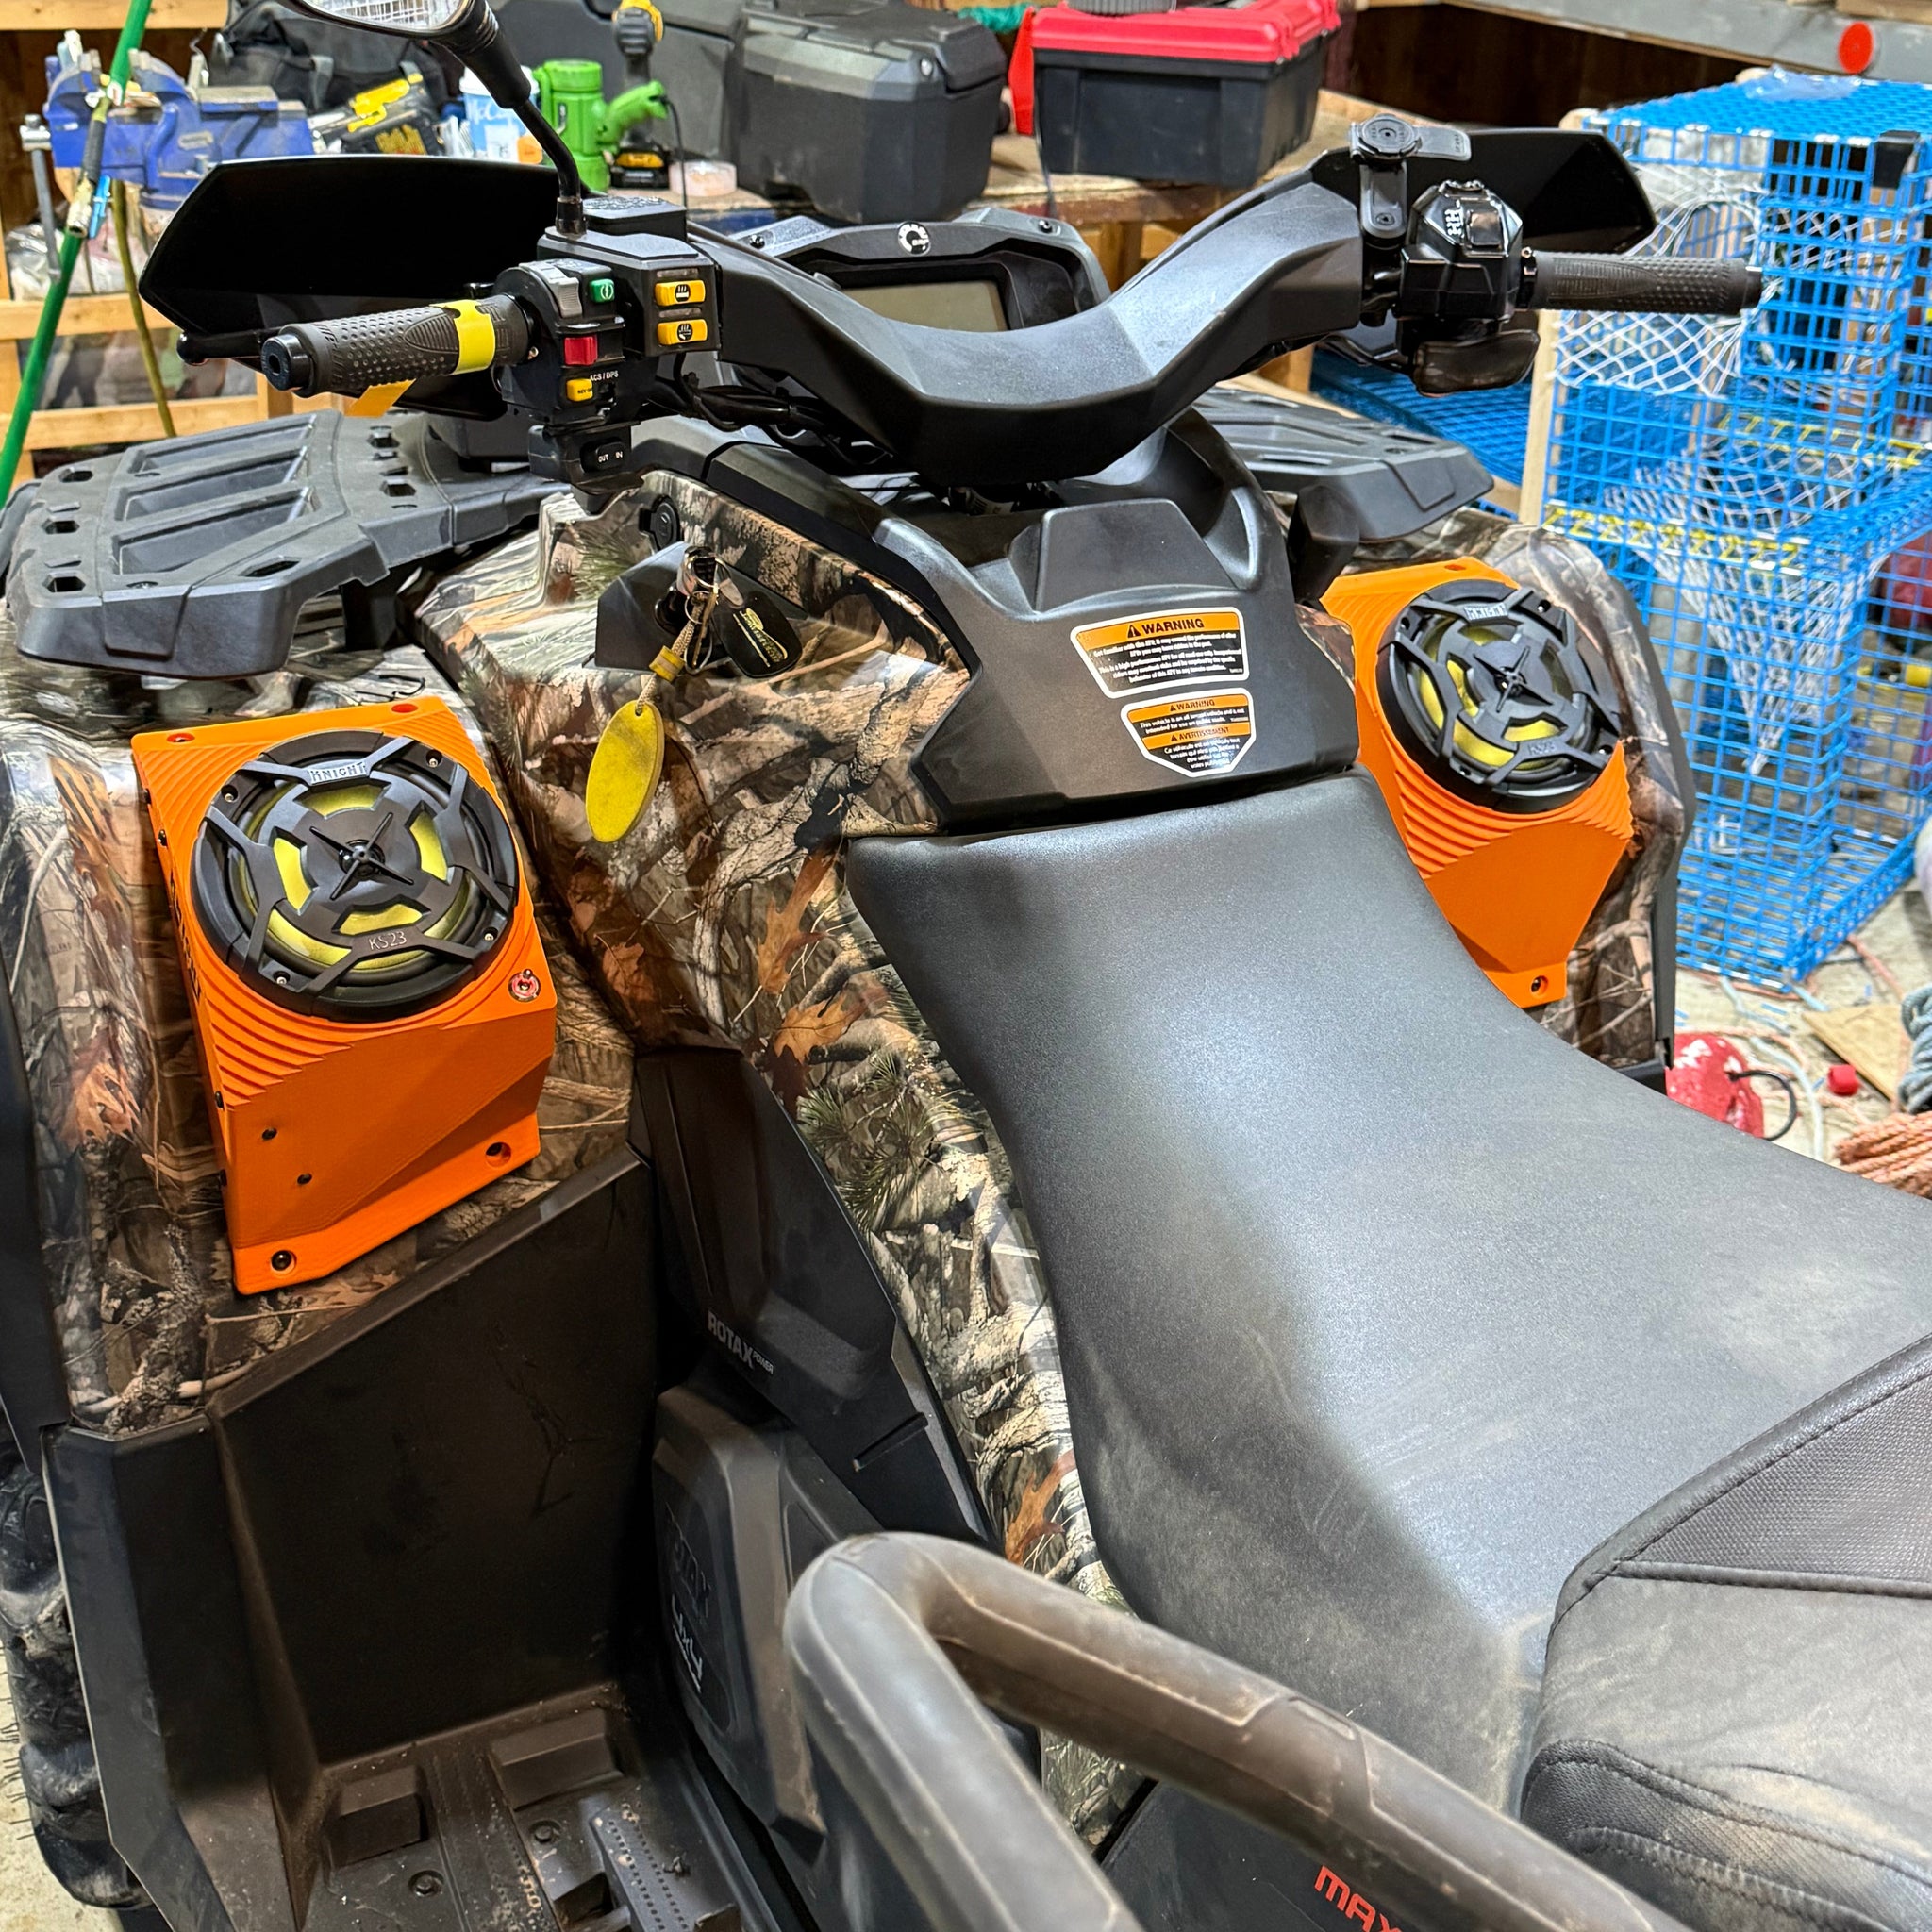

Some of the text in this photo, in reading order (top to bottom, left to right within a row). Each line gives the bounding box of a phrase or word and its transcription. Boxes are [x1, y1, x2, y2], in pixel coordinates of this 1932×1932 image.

[606, 371, 619, 379] DPS
[598, 454, 608, 463] OUT
[1141, 618, 1205, 635] WARNING
[1176, 699, 1215, 710] WARNING
[310, 761, 366, 782] KNIGHT
[369, 931, 407, 950] KS23
[708, 1311, 754, 1369] ROTAX
